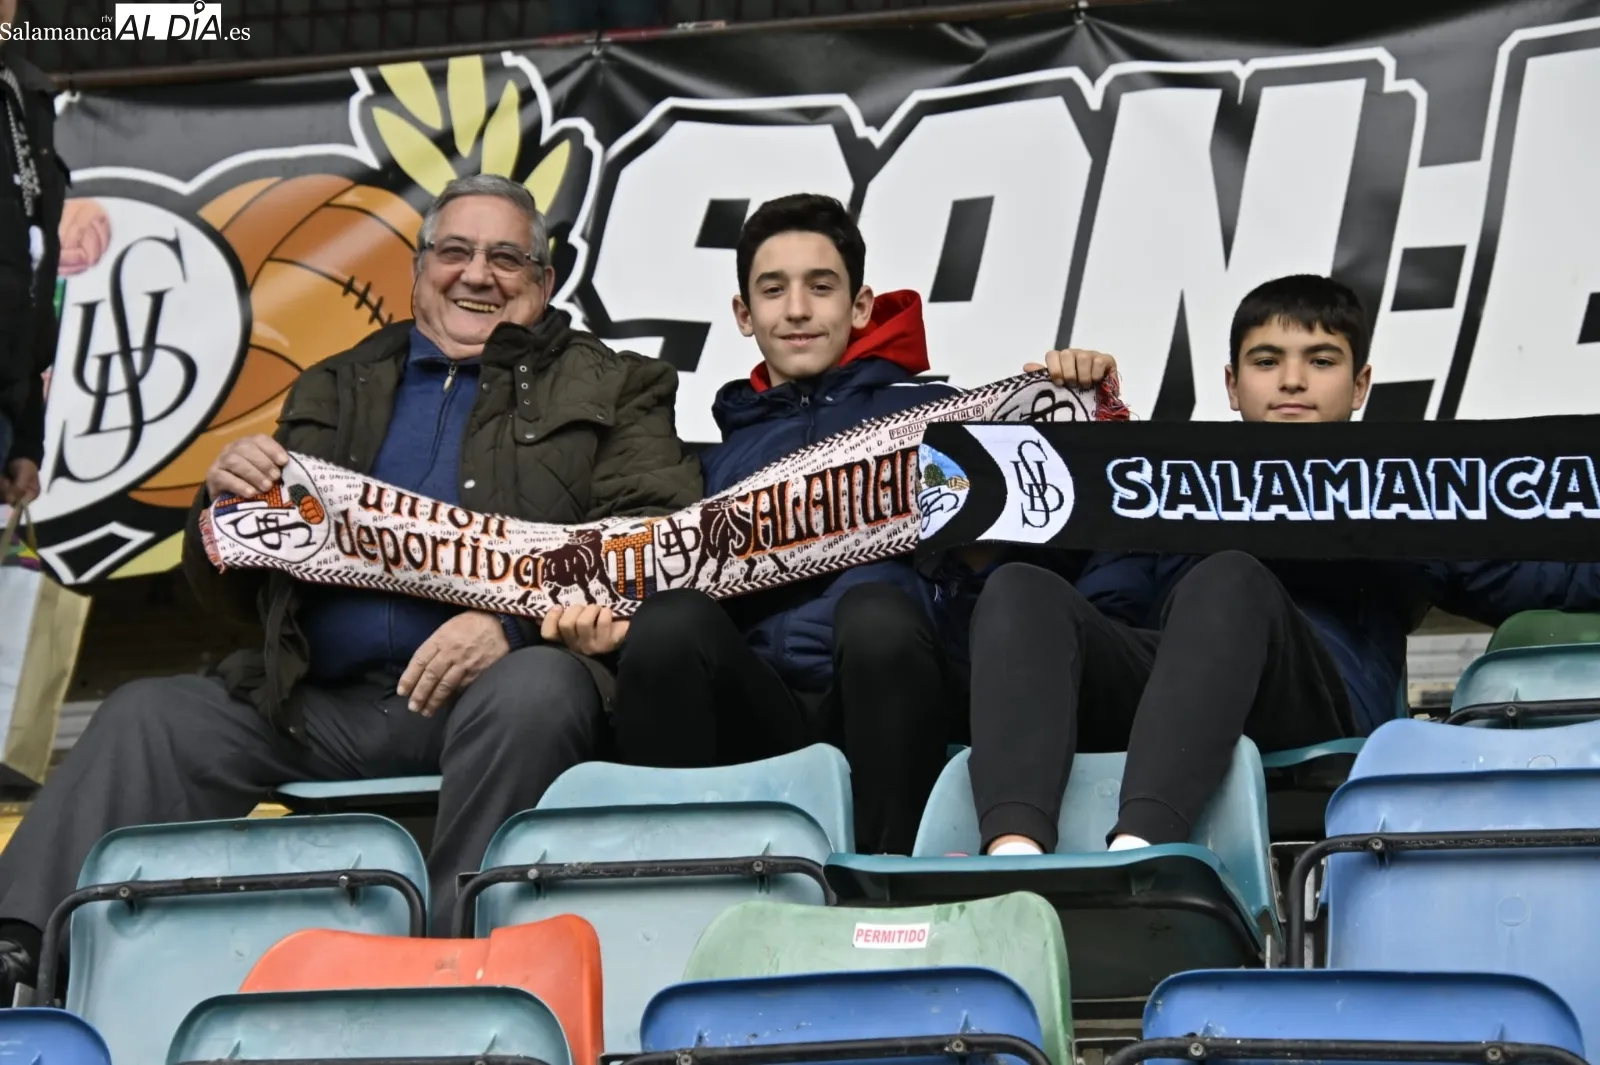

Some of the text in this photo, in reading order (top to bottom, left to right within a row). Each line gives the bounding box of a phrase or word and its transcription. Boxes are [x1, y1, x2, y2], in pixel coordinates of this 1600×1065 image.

[1106, 456, 1600, 521] SALAMANCA
[333, 507, 545, 592] deportiva
[855, 928, 926, 944] PERMITIDO
